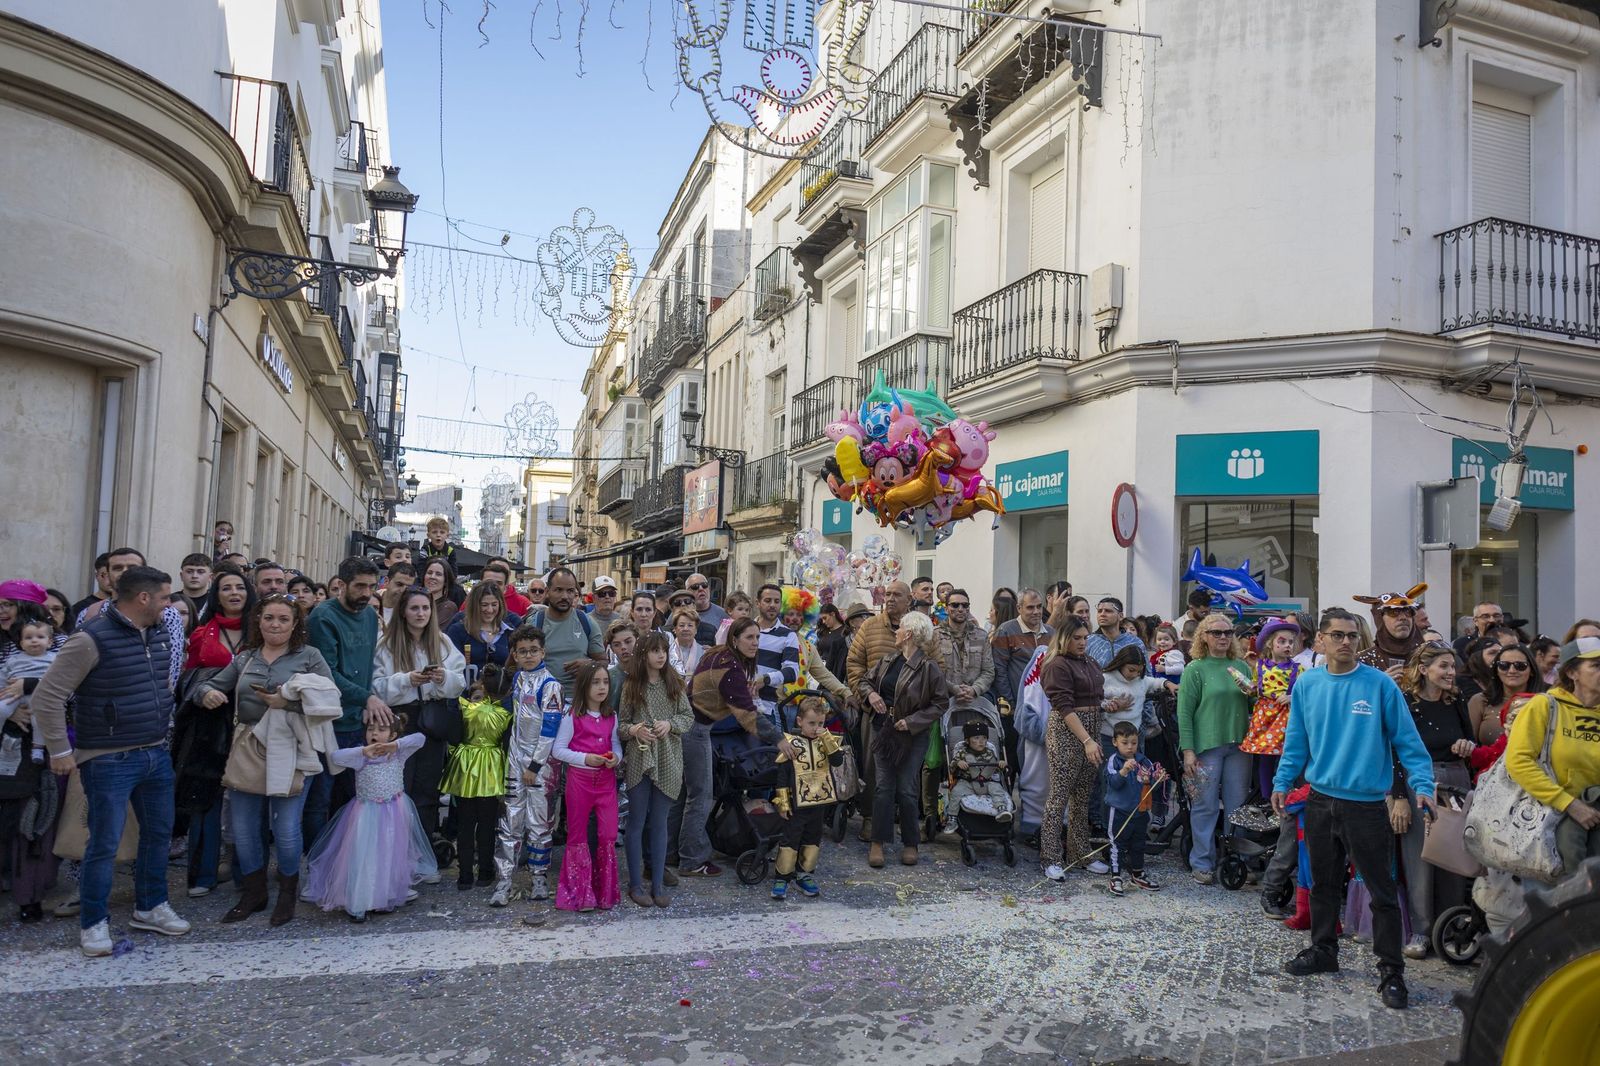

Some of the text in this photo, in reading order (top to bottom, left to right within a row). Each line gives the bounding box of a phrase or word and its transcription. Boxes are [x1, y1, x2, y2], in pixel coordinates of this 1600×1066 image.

[1015, 472, 1064, 496] cajamar
[1048, 487, 1063, 495] RURAL
[1529, 486, 1566, 496] CAJA RURAL
